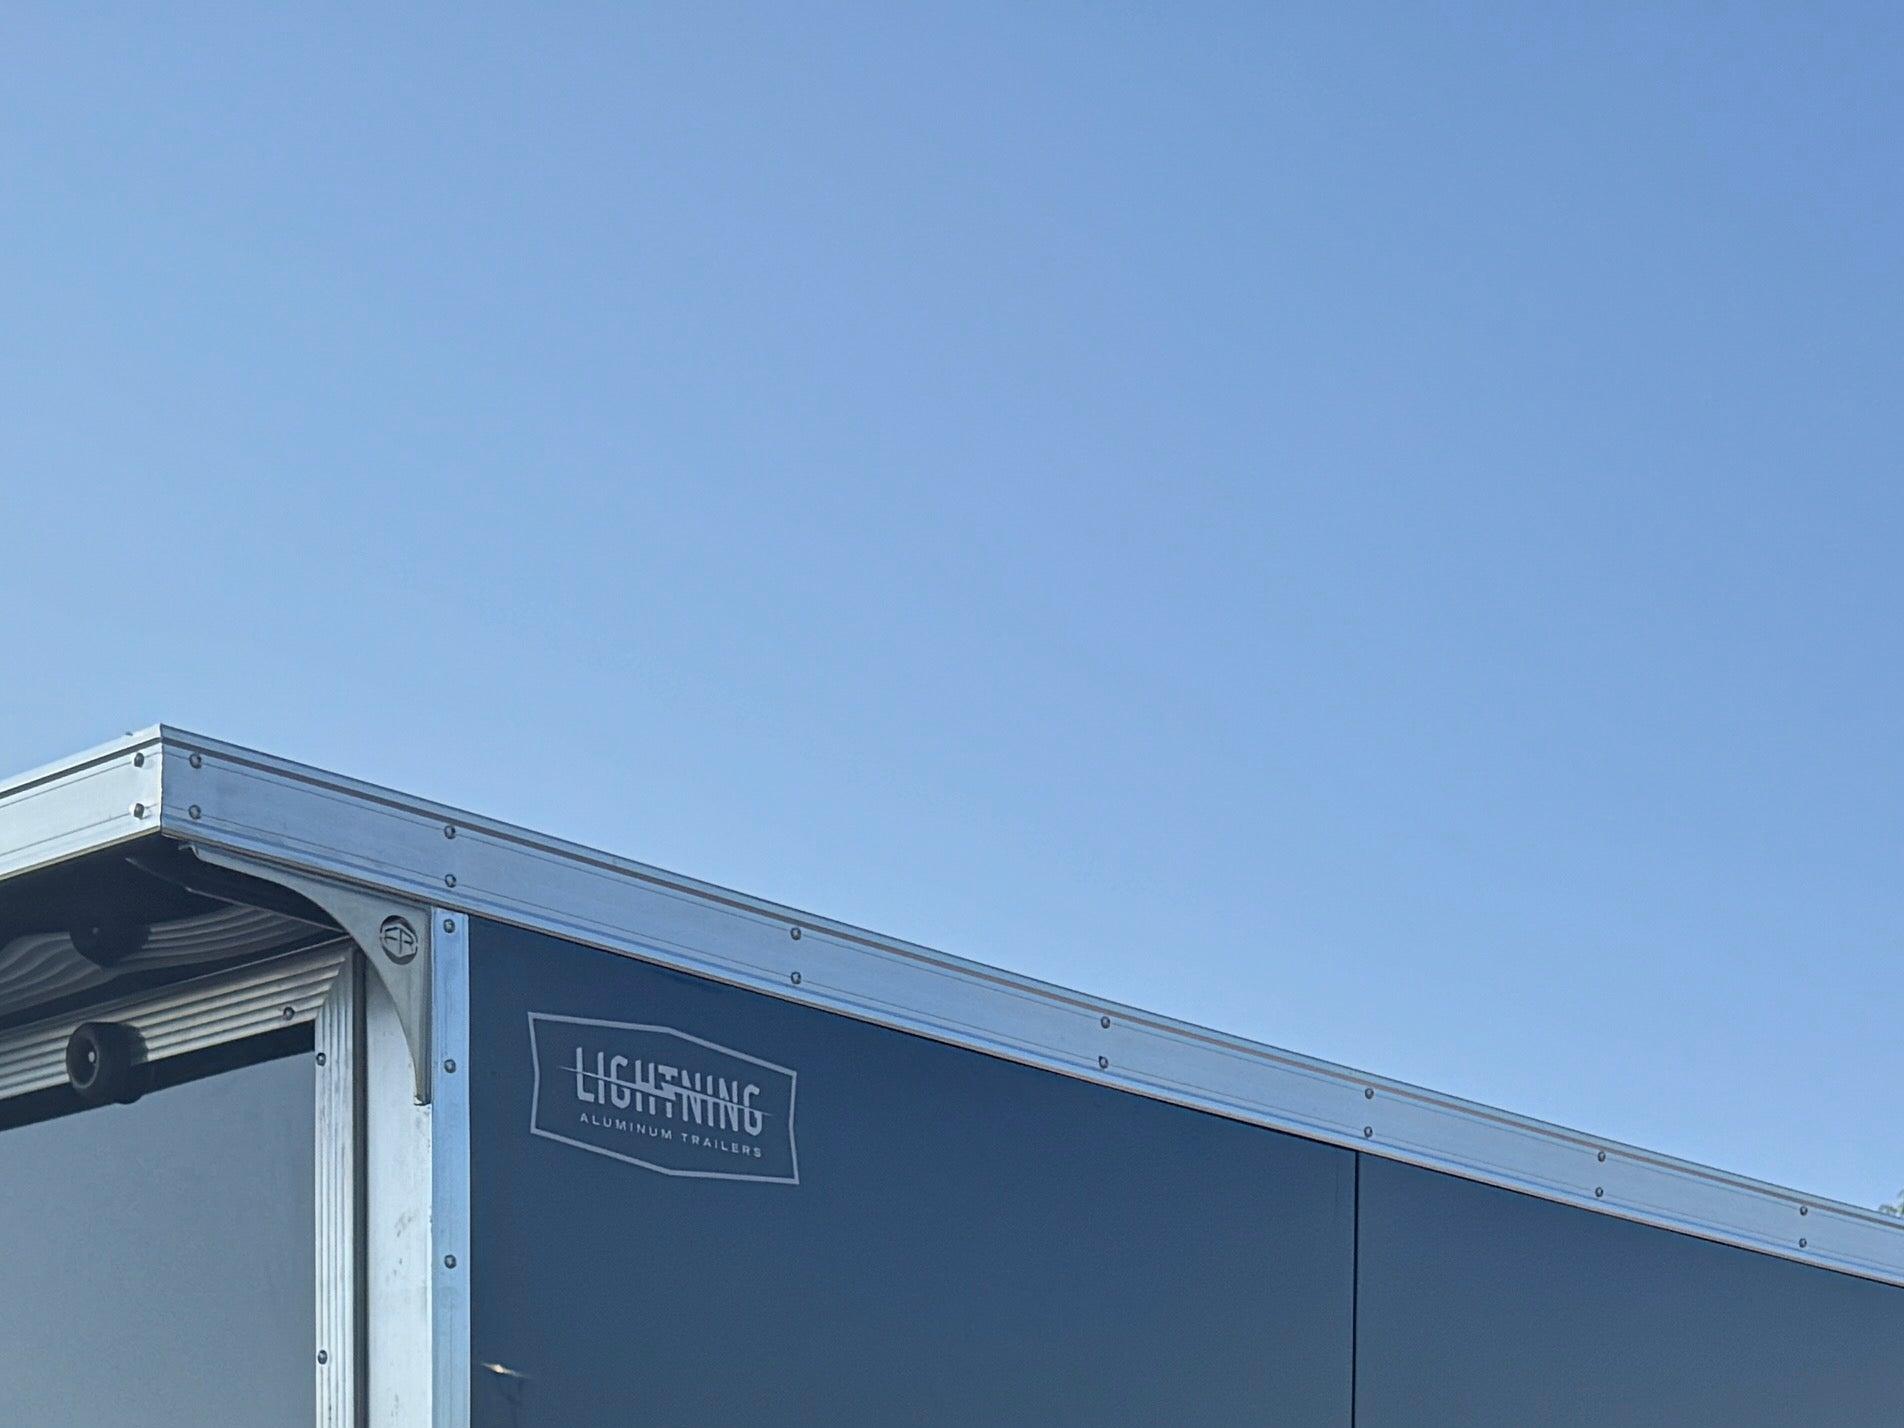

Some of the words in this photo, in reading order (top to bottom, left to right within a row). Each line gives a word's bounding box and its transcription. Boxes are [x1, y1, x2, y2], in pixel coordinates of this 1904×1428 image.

[574, 1047, 764, 1136] LIGHTNING
[580, 1112, 673, 1140] ALUMINUM
[681, 1132, 762, 1158] TRAILERS
